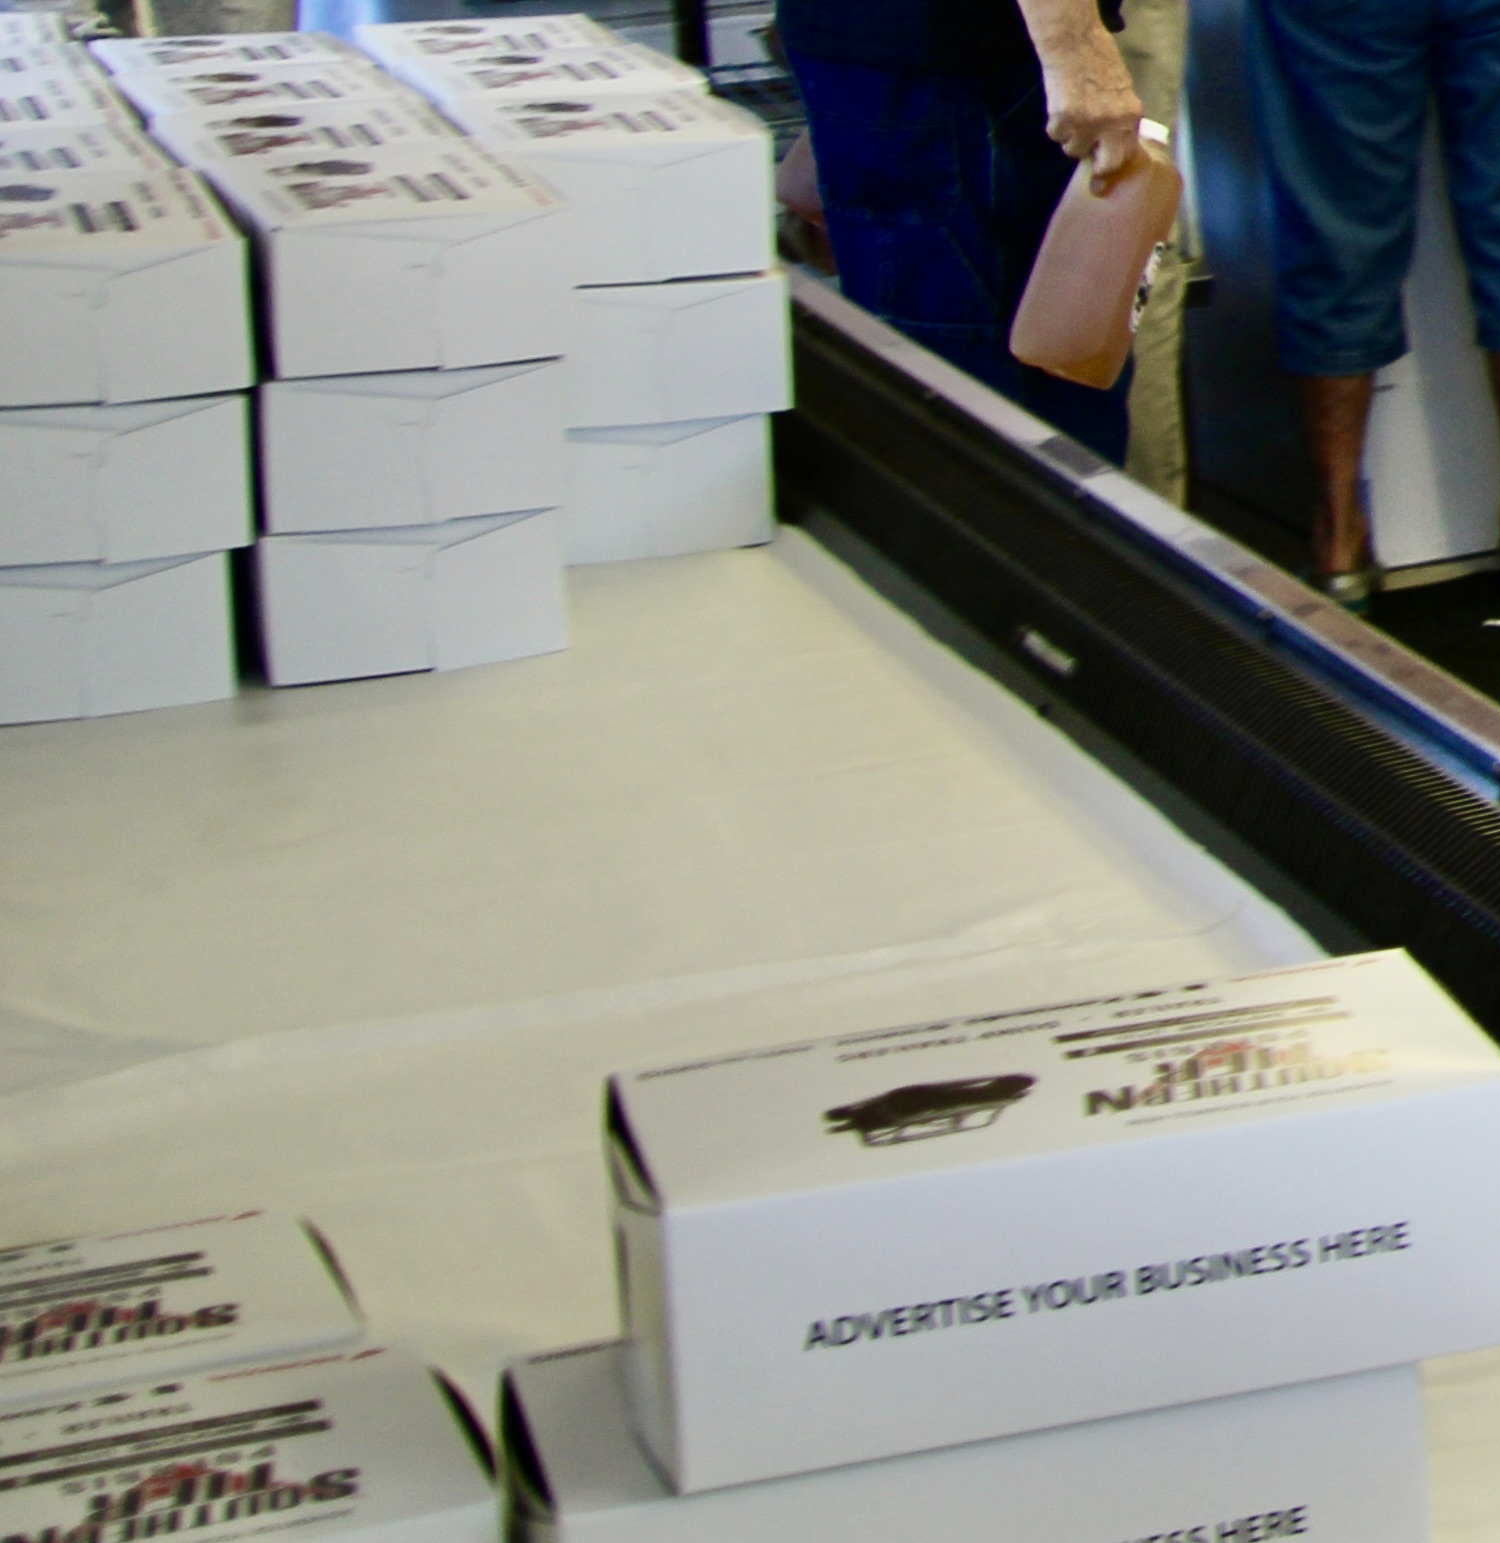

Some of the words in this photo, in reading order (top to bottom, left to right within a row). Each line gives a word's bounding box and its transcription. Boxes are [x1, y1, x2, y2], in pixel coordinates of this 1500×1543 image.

[1082, 1048, 1393, 1117] SOUTHERN
[806, 1282, 1017, 1351] ADVERTISE
[1021, 1269, 1126, 1314] YOUR
[1136, 1238, 1312, 1297] BUSINESS
[1319, 1220, 1413, 1266] HERE
[1216, 1504, 1310, 1543] HERE
